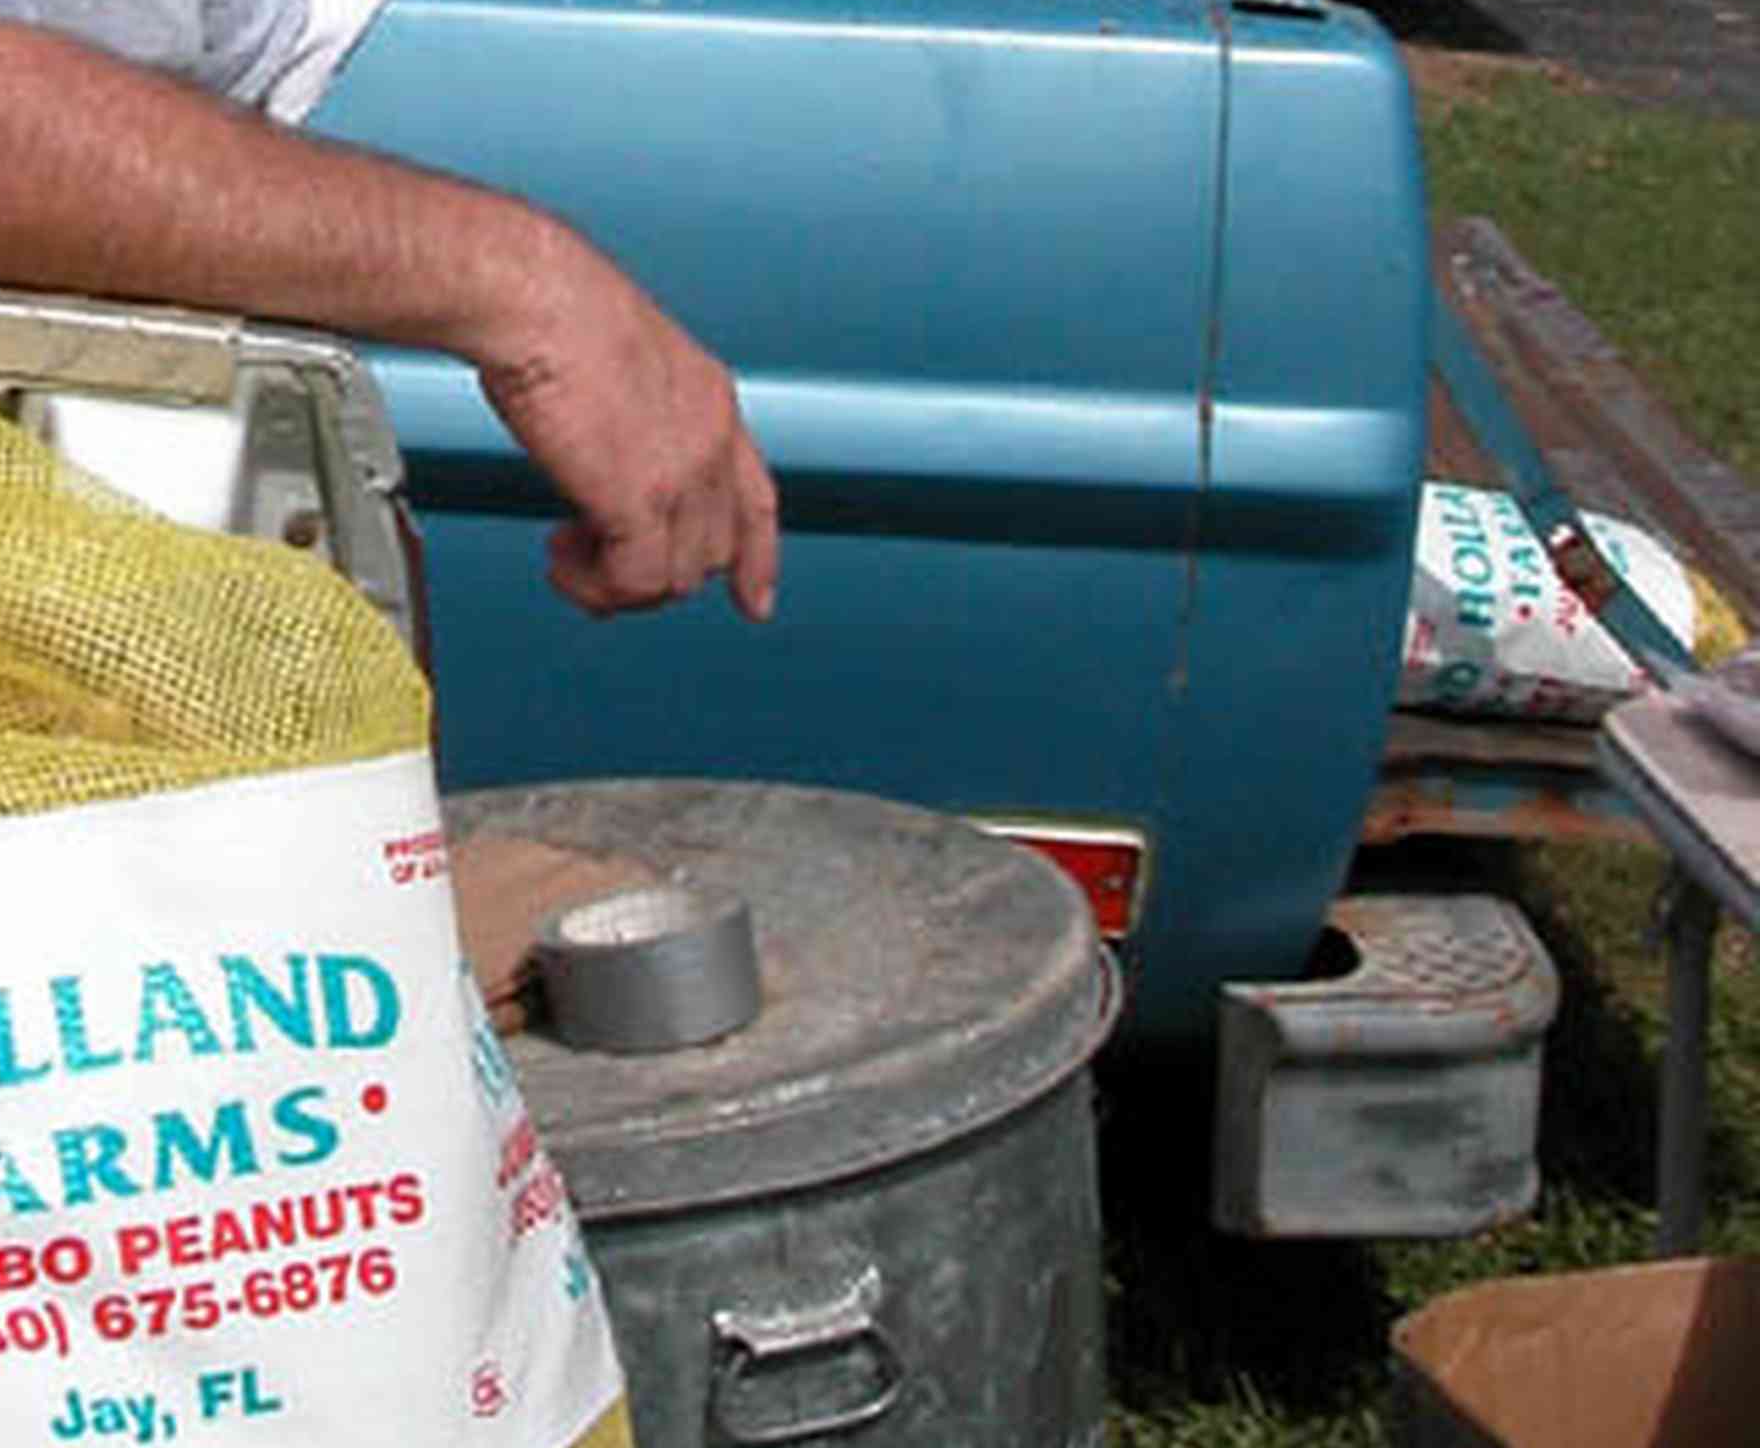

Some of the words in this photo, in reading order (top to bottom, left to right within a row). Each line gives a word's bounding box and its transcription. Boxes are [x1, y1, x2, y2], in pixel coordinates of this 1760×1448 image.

[120, 1173, 426, 1278] PEANUTS
[92, 1249, 398, 1338] 675-6876
[50, 1377, 179, 1443] Jay,
[200, 1367, 283, 1422] FL
